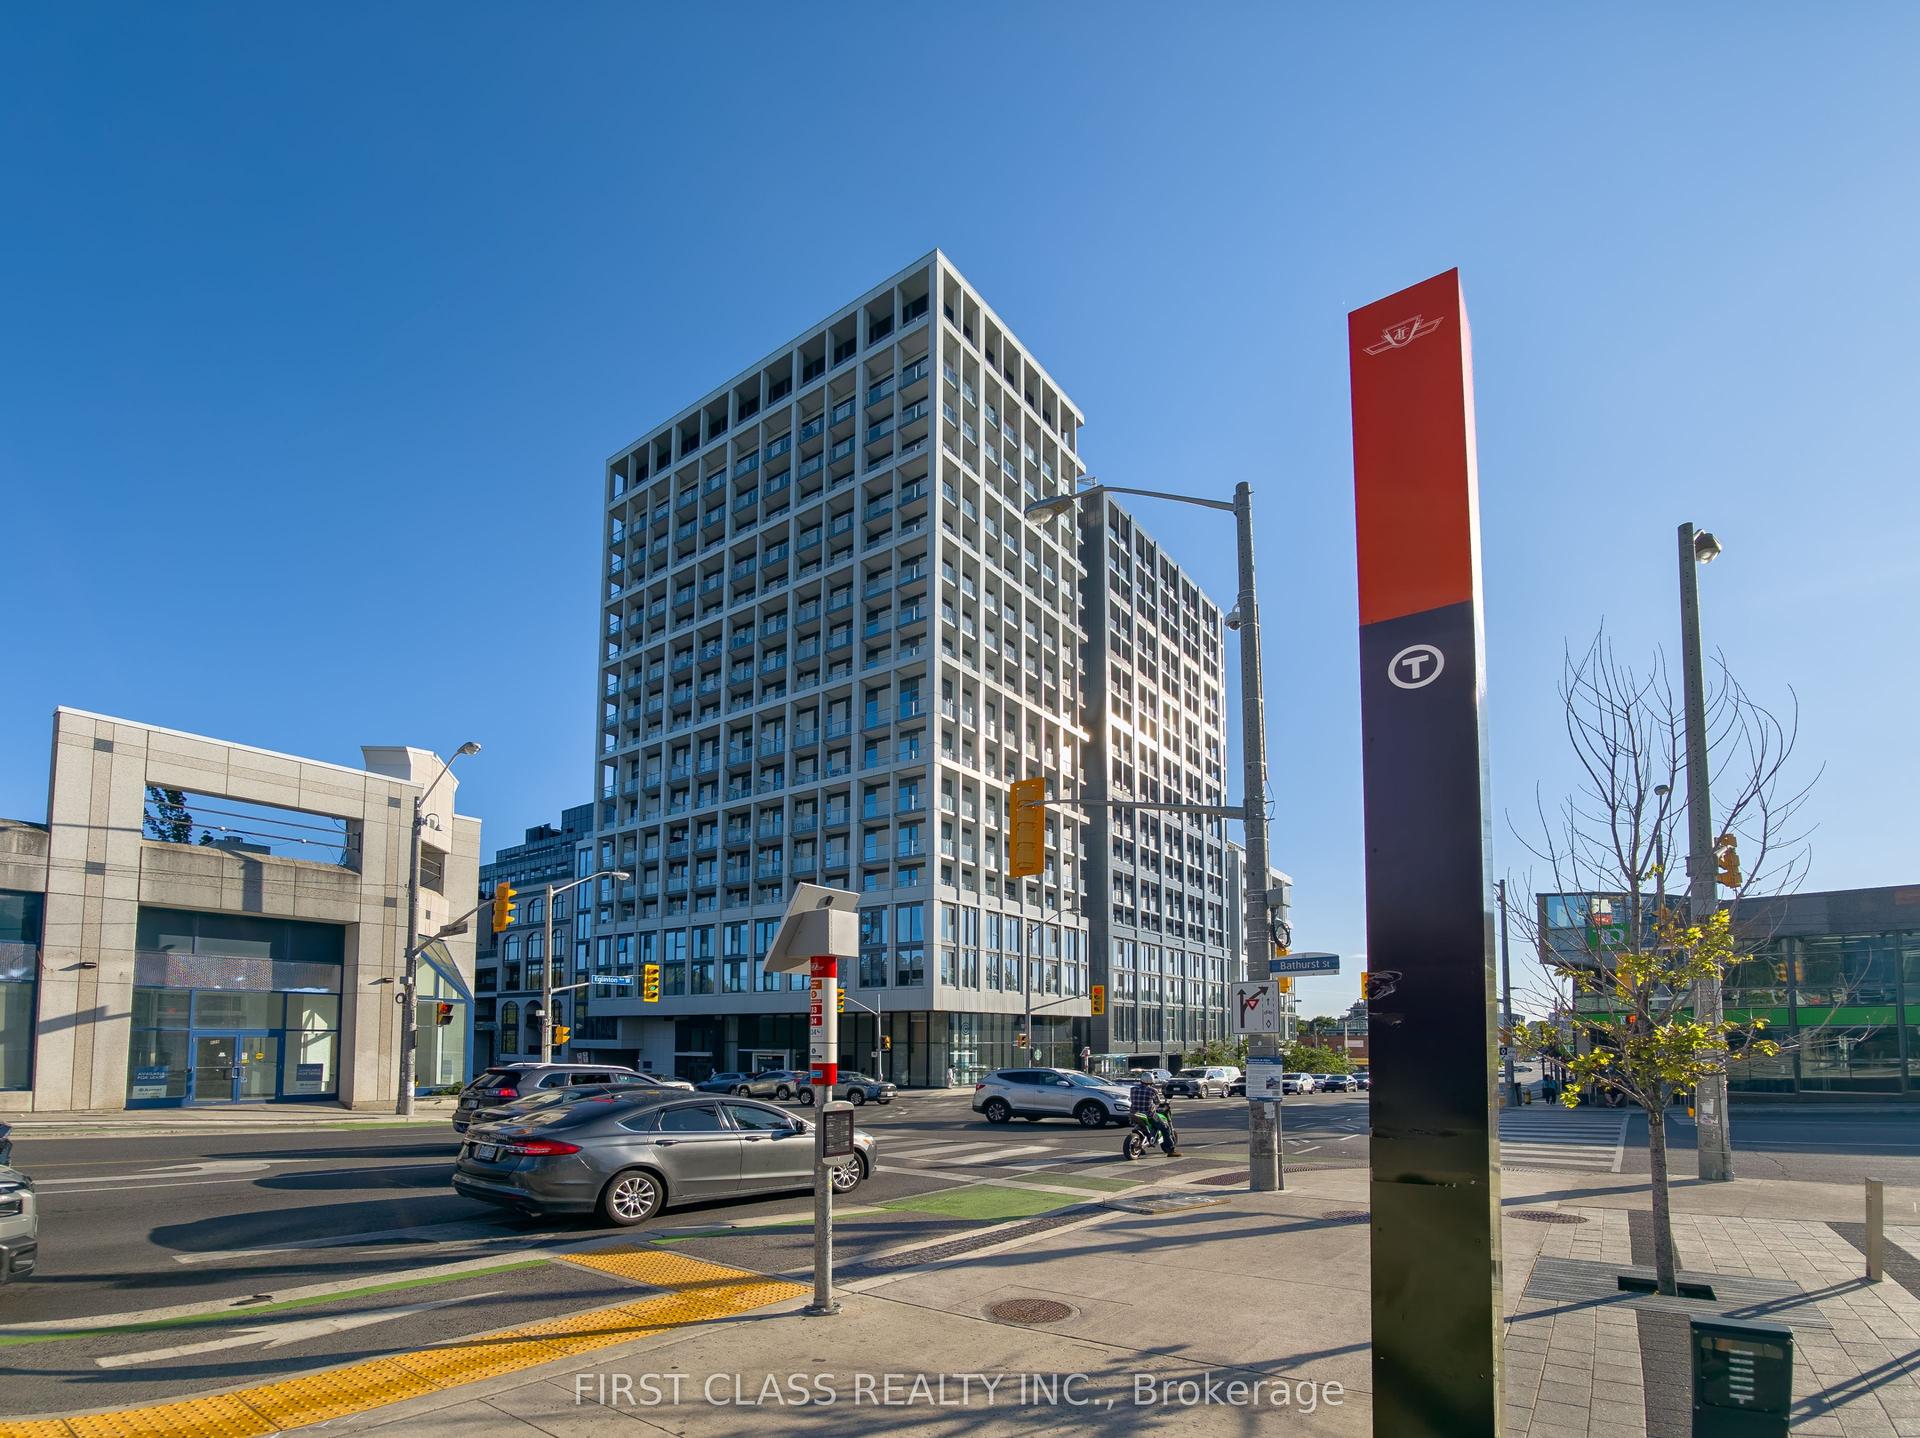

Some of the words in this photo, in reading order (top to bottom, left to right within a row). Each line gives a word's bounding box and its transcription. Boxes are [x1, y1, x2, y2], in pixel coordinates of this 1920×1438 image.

[1402, 654, 1429, 680] T
[1280, 960, 1320, 970] Bathurst
[1322, 960, 1330, 968] St
[594, 976, 618, 985] Eglinton
